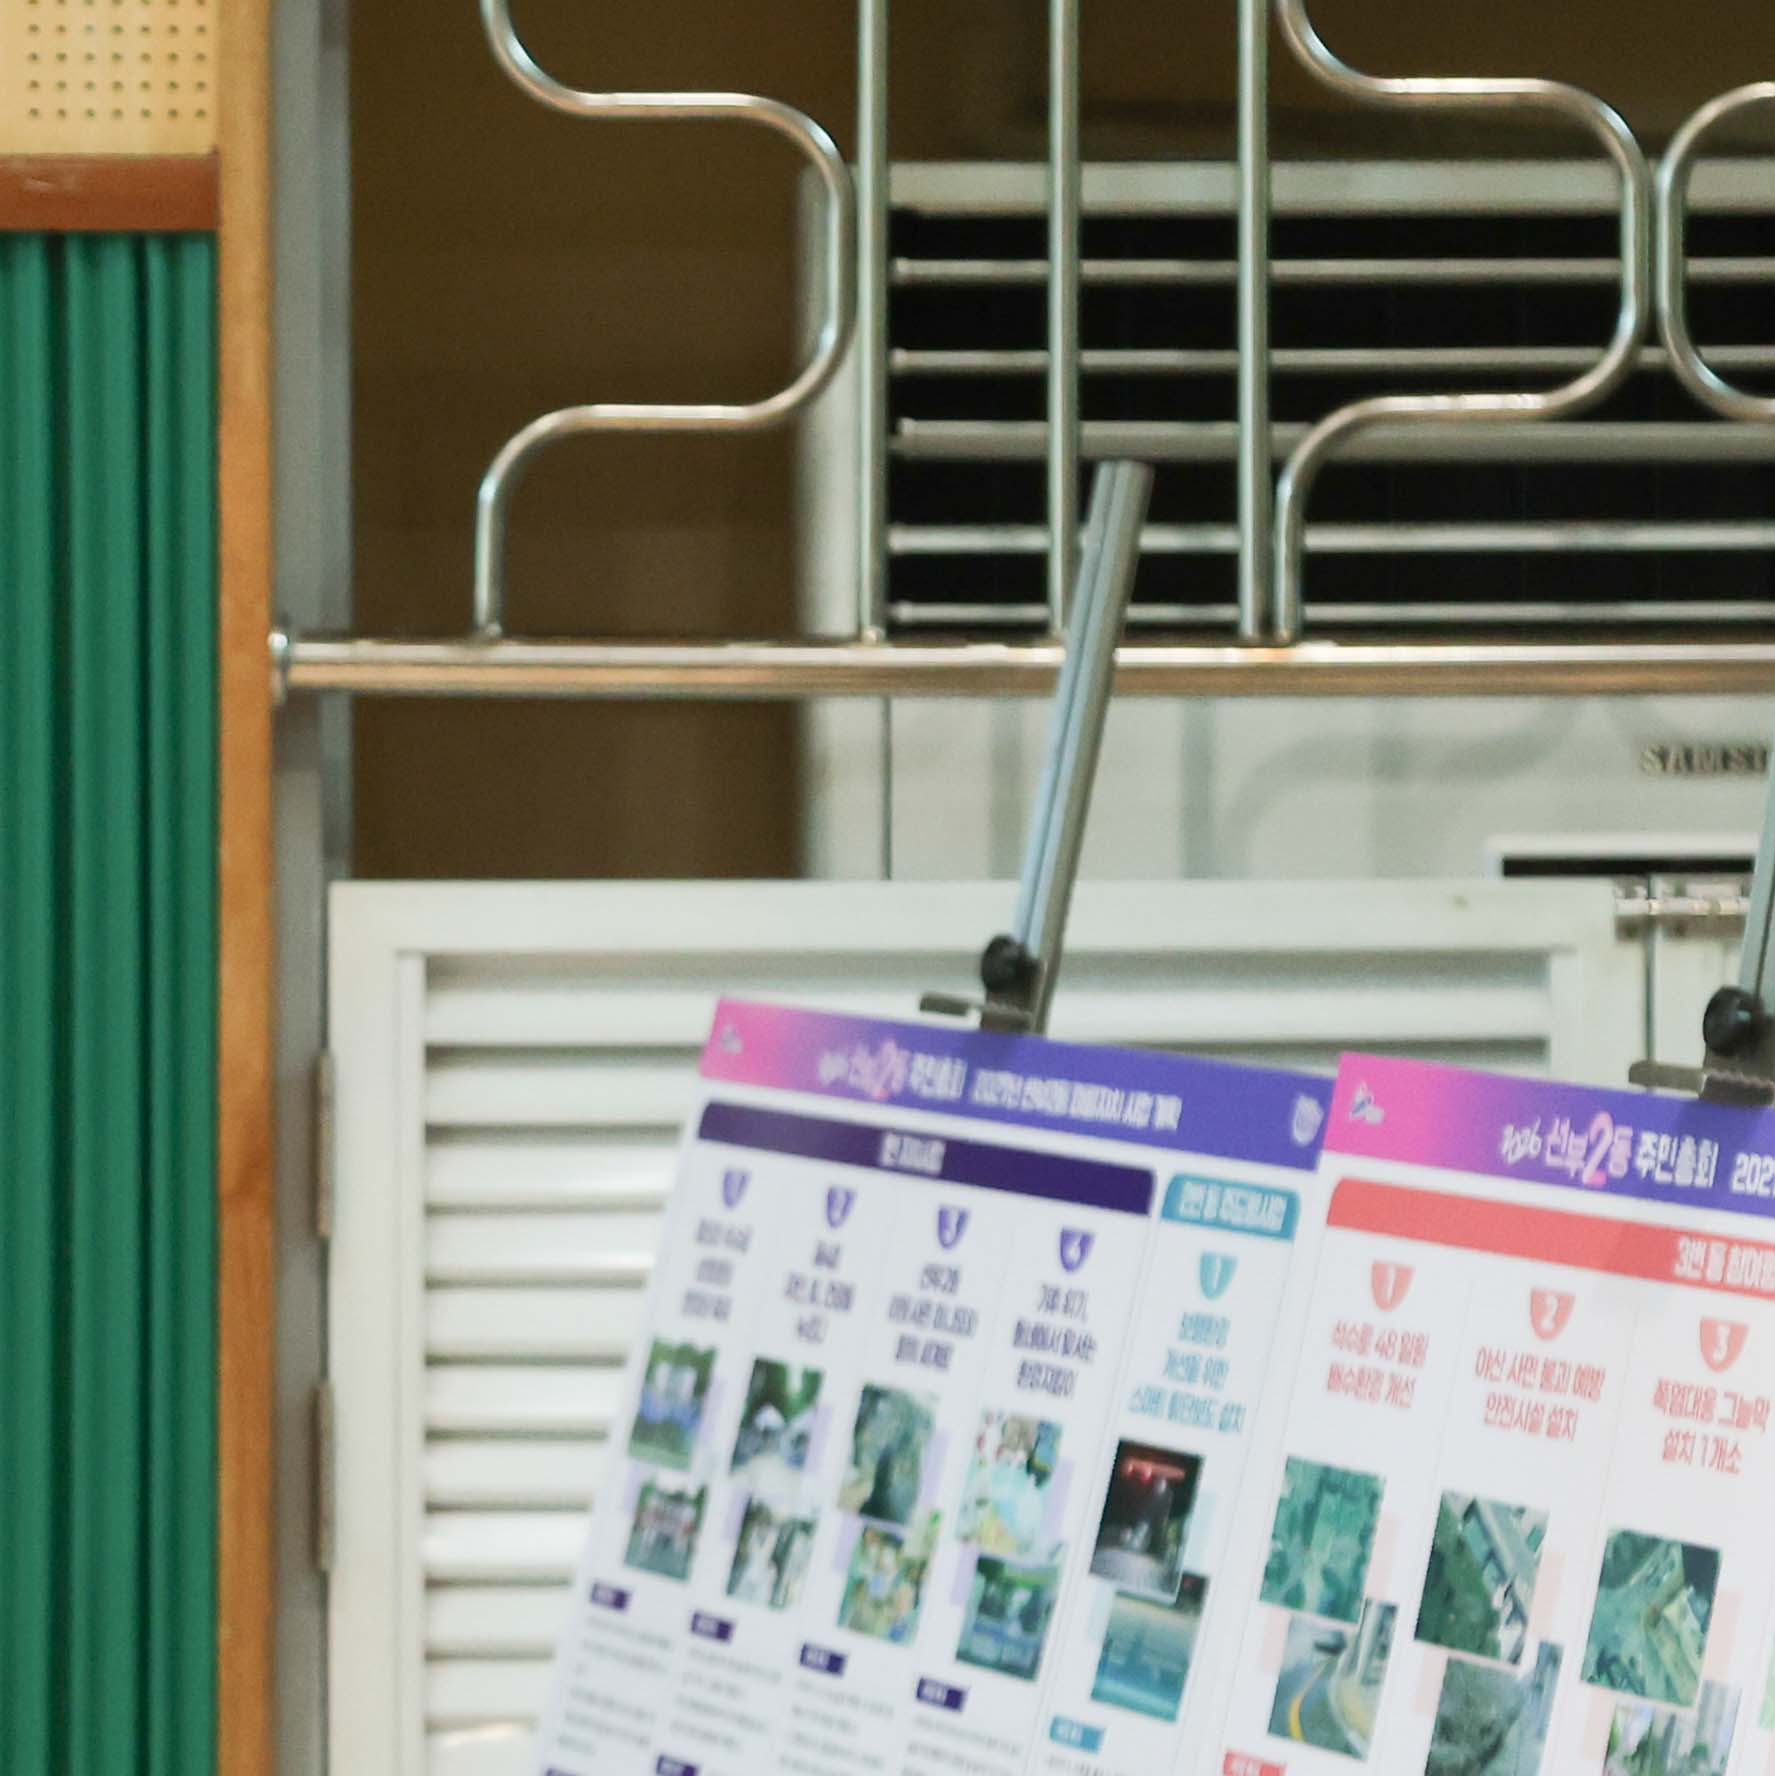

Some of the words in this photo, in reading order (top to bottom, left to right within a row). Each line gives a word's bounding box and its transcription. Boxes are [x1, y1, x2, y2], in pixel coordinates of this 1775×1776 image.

[1544, 1111, 1633, 1186] 선부2동
[1634, 1130, 1719, 1188] 주민총회
[1540, 1294, 1559, 1331] 2
[1483, 1391, 1546, 1435] 안전시설
[1545, 1404, 1579, 1441] 설치
[1718, 1391, 1771, 1435] 그늘막
[1662, 1427, 1697, 1465] 설치
[1699, 1433, 1743, 1475] 1개소
